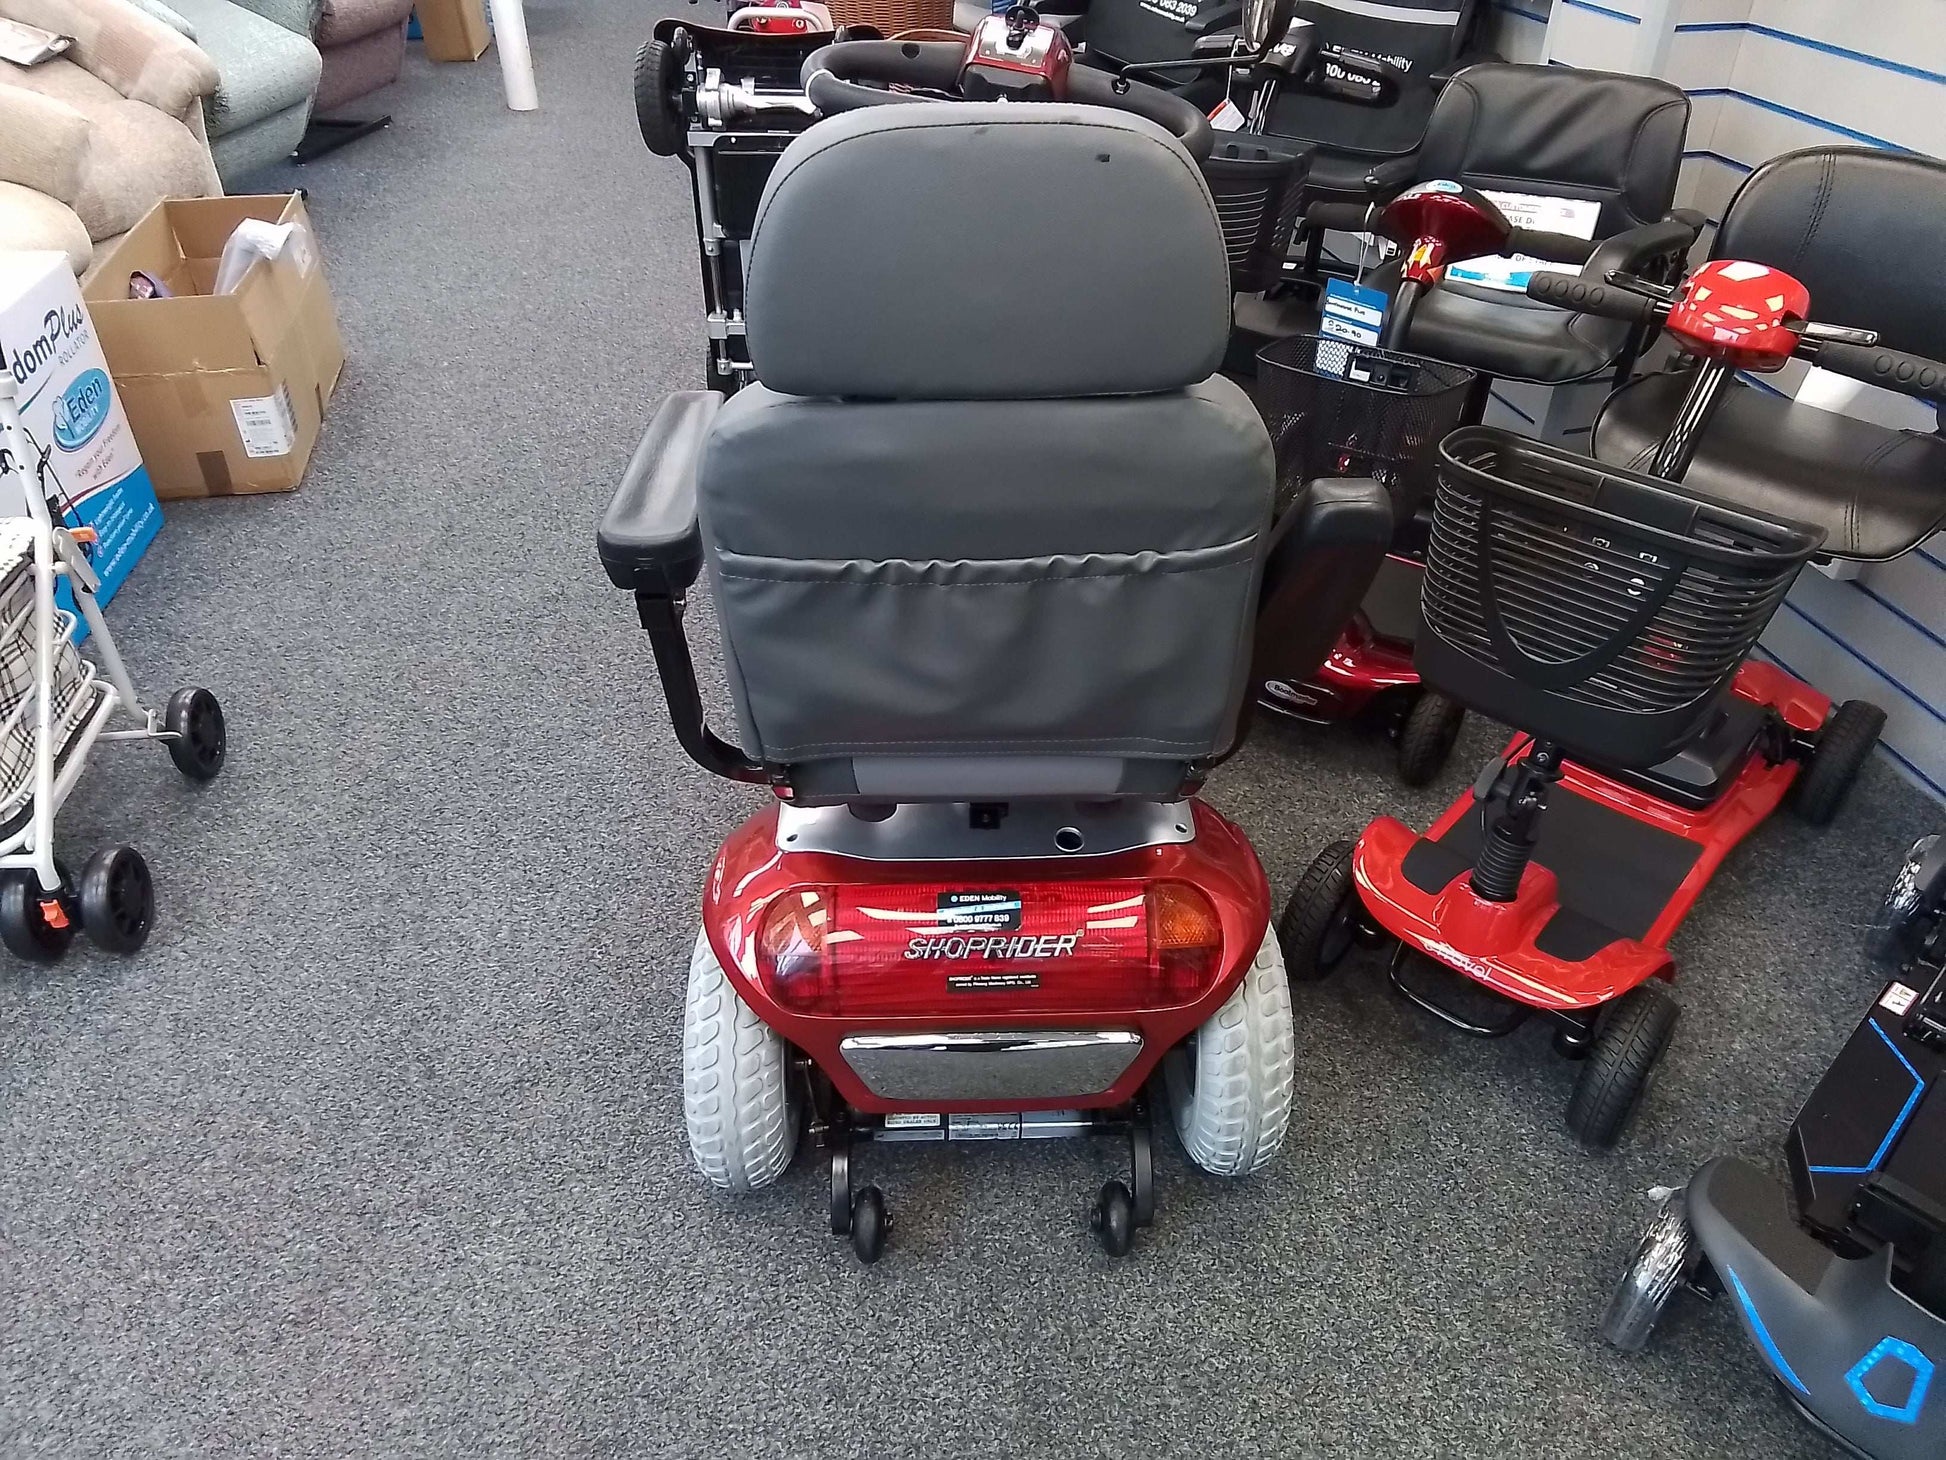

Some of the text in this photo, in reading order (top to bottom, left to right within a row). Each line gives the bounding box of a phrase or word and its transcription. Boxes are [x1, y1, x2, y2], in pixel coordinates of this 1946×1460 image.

[1175, 1, 1198, 17] 2039
[58, 329, 90, 366] ROLLATOR
[67, 378, 103, 423] Eden
[981, 894, 1007, 902] Mobility
[904, 935, 1077, 960] SHOPRIDER
